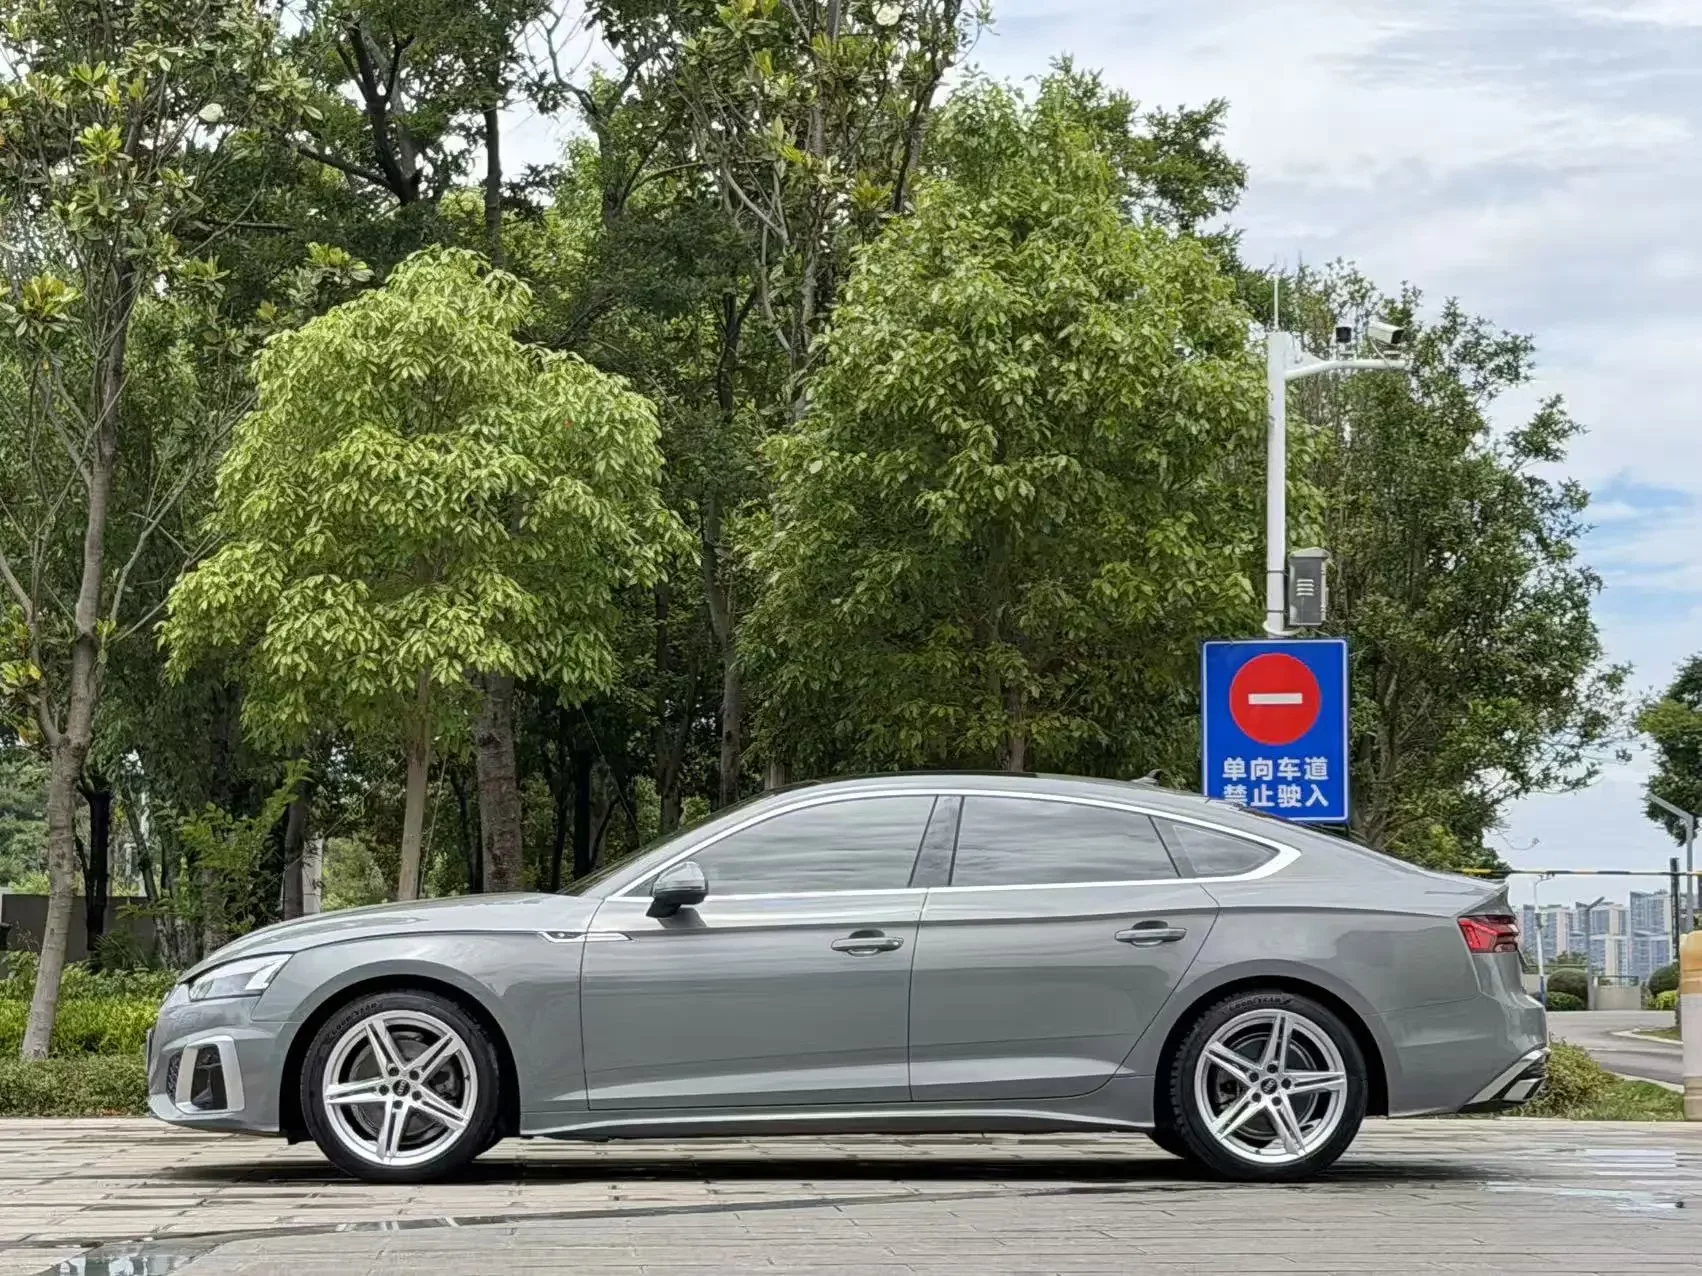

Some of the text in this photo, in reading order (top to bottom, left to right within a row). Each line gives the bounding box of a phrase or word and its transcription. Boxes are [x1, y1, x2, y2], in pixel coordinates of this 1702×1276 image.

[1222, 757, 1329, 781] 单向车道
[1223, 784, 1329, 808] 禁止驶入
